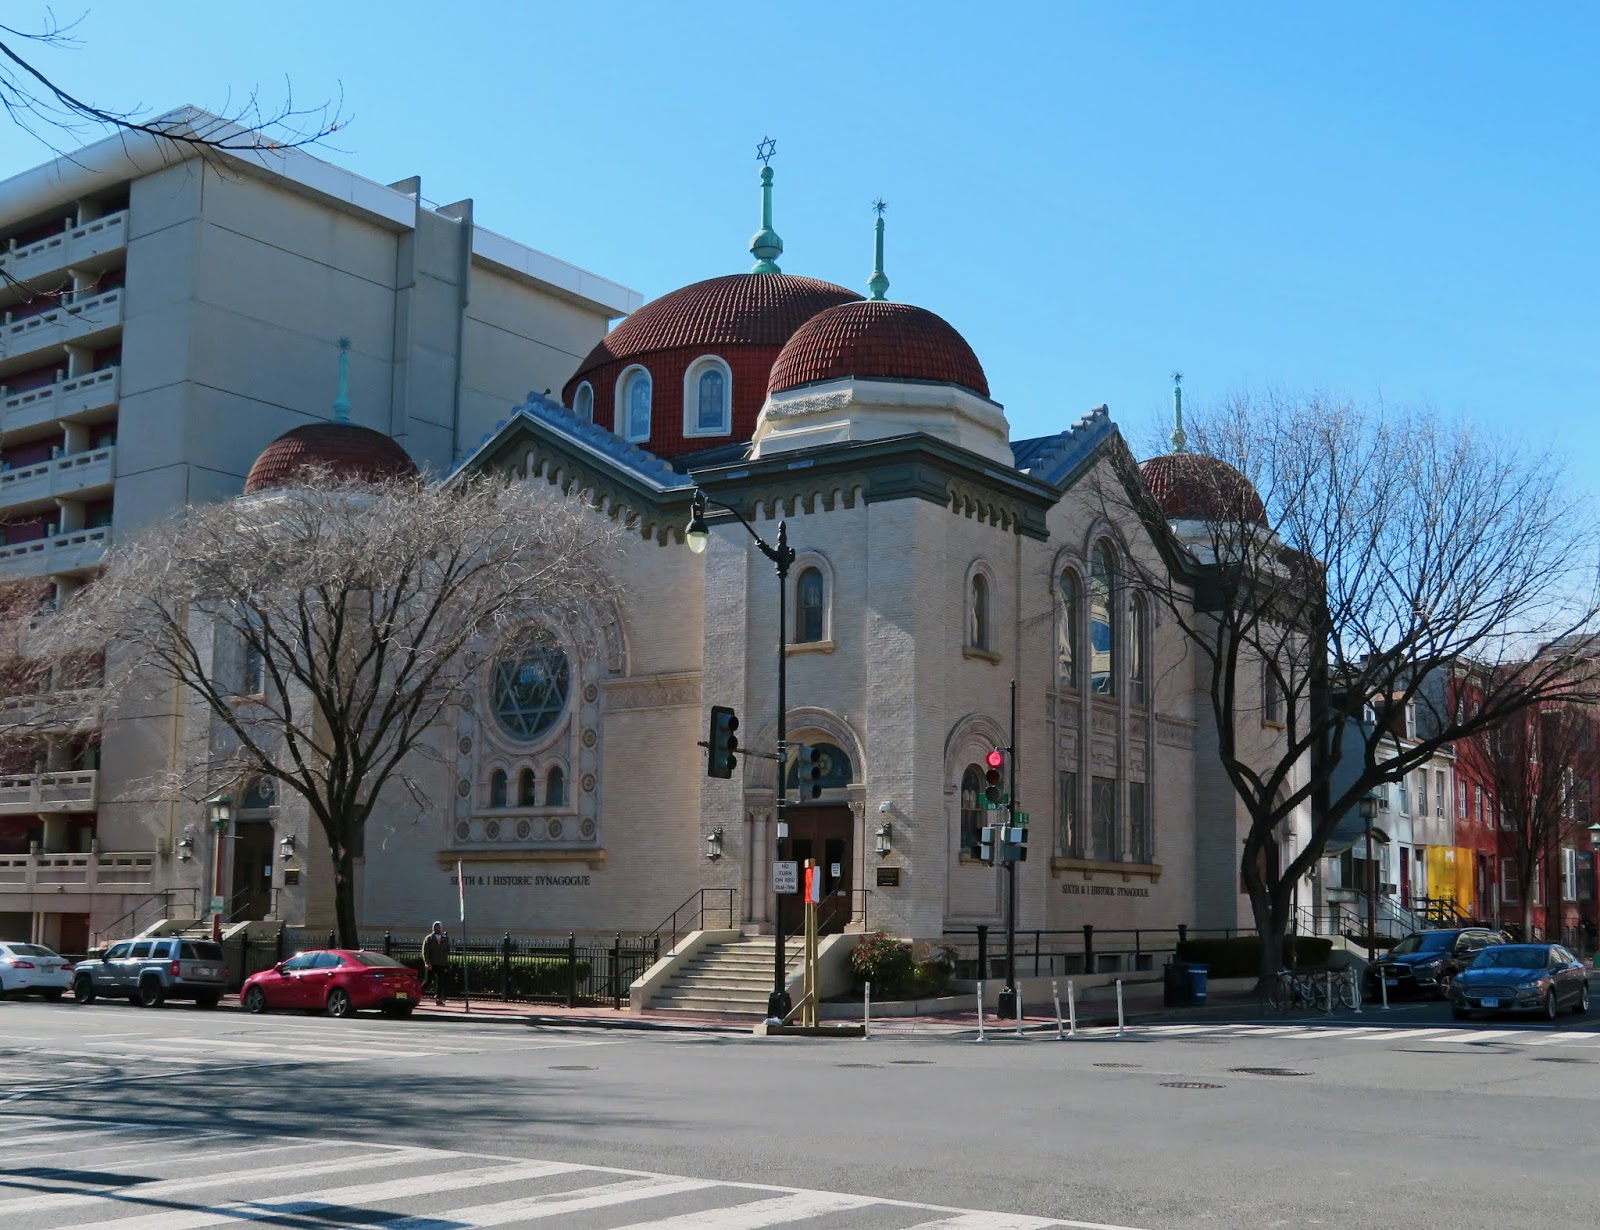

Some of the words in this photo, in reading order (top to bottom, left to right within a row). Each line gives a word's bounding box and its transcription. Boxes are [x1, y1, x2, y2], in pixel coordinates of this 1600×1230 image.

[478, 876, 483, 885] &
[487, 876, 490, 885] I
[493, 875, 532, 886] HISTORIC
[534, 875, 590, 886] SYNAGOGUE
[1062, 884, 1079, 894] SIXTH
[1081, 885, 1085, 894] &
[1087, 885, 1090, 894] I
[1091, 885, 1115, 896] HISTORIC
[1117, 887, 1149, 897] SYNAGOGUE
